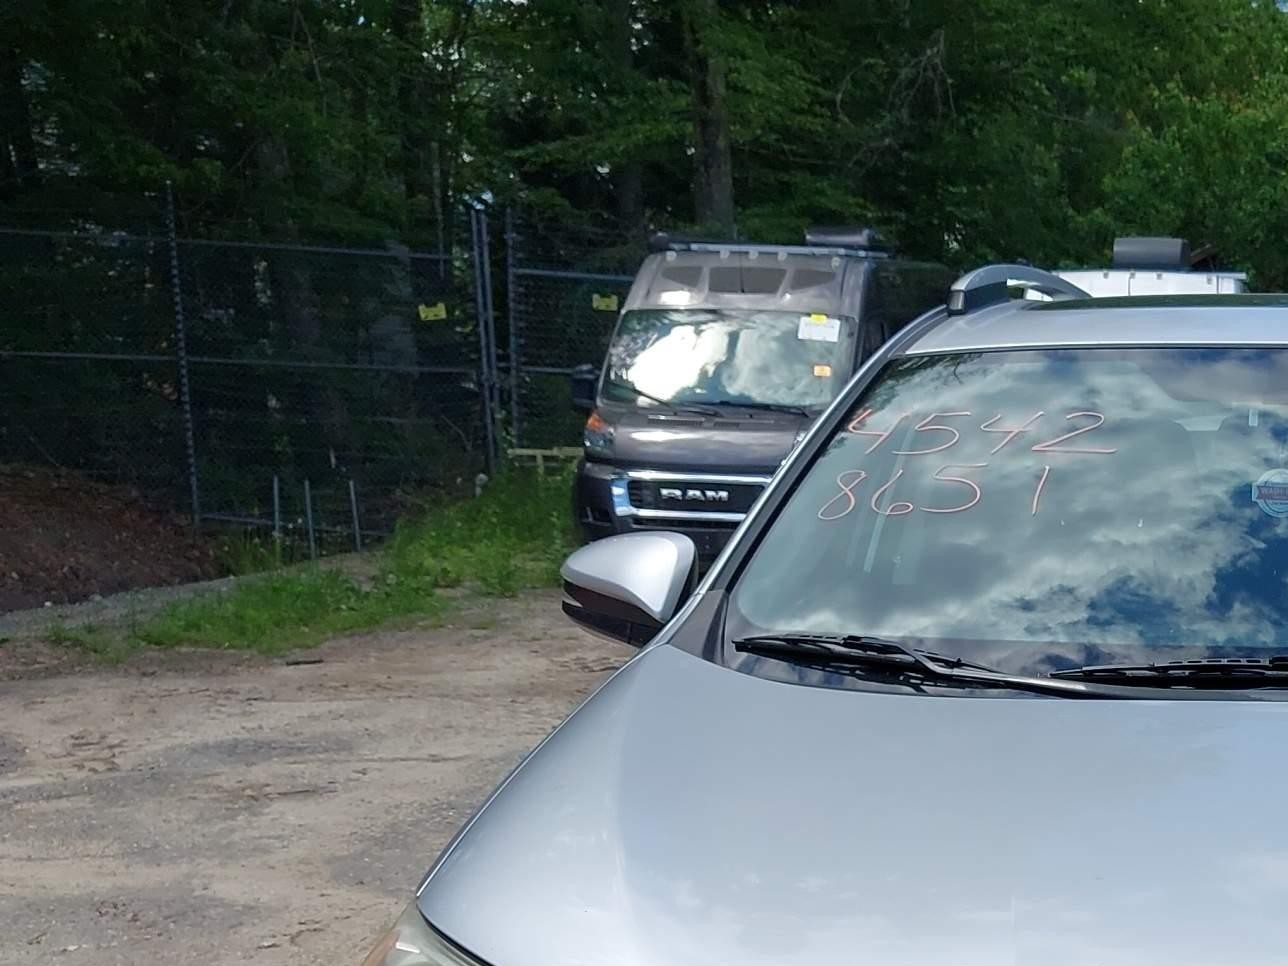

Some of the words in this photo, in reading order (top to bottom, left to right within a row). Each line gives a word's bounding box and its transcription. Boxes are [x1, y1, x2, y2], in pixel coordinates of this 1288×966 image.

[848, 408, 1118, 455] 4542
[659, 487, 729, 502] RAM
[818, 463, 1051, 520] 8651
